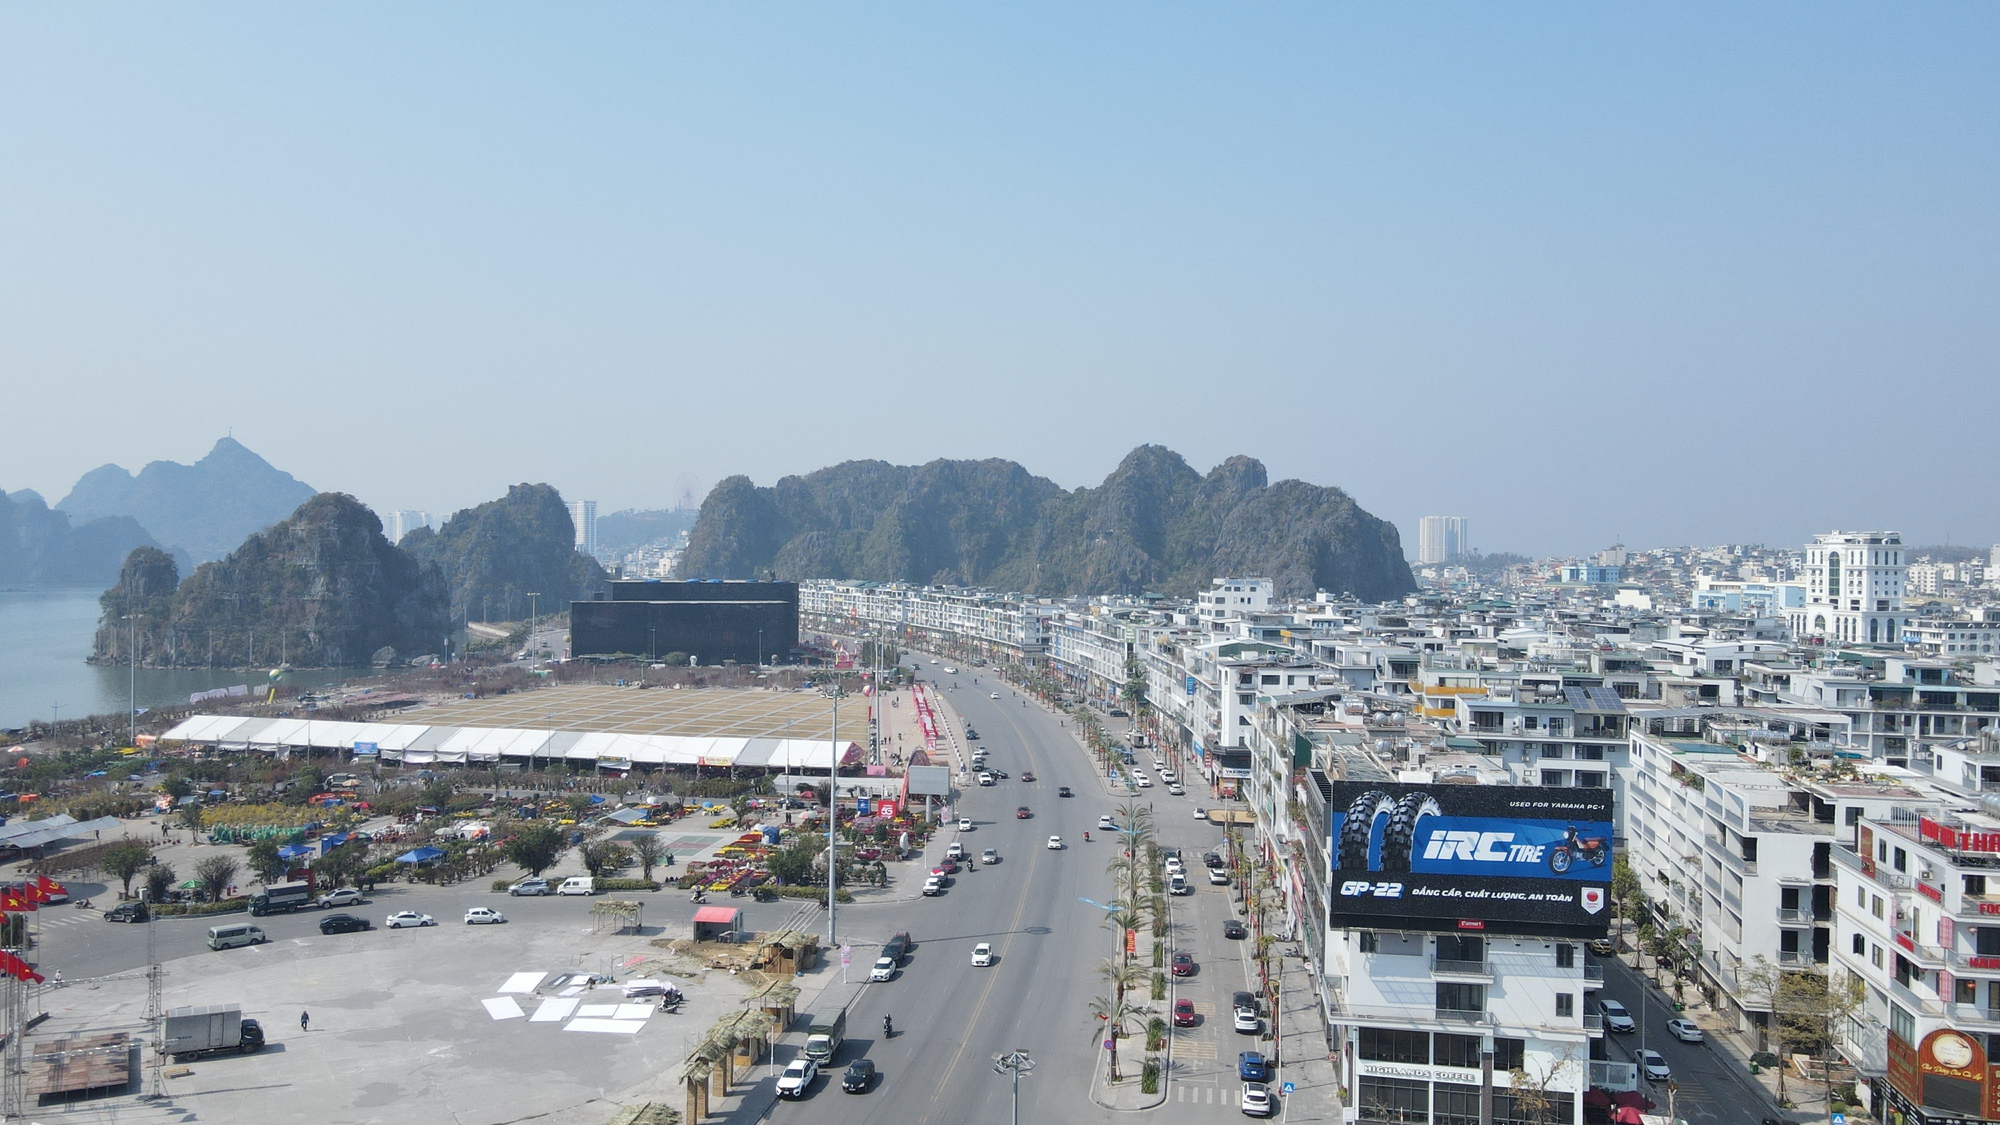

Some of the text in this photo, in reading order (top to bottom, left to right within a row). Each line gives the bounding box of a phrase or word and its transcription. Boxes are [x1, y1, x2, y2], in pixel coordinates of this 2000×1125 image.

[1508, 844, 1546, 863] TIRE
[1340, 881, 1404, 898] GP-22
[1464, 889, 1490, 898] CHẤT
[1545, 893, 1574, 902] TOÀN
[1364, 1065, 1476, 1082] HIGHLANDS COFFEE
